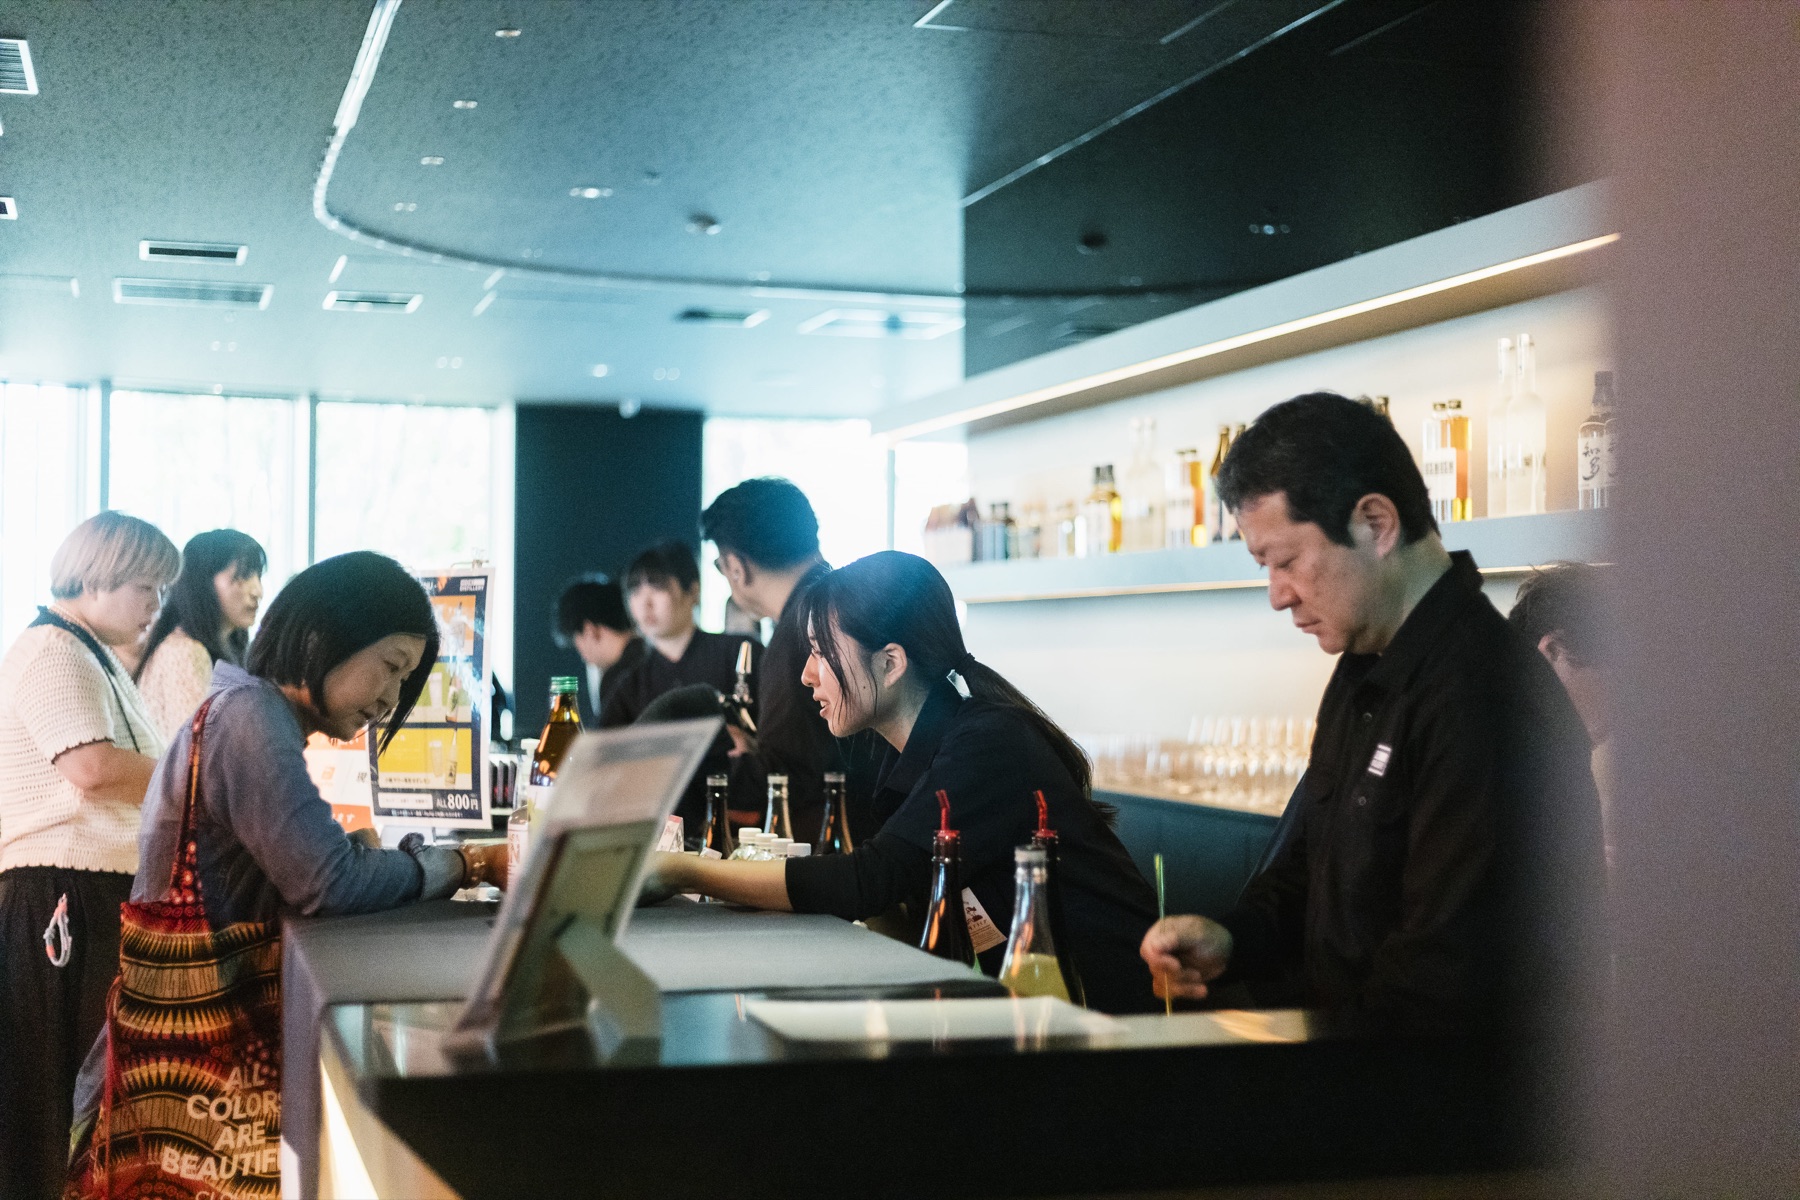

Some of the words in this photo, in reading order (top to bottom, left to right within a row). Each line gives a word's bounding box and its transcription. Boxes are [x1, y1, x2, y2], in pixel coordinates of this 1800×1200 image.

[436, 798, 448, 808] ALL
[447, 793, 479, 810] 800円
[224, 1063, 265, 1091] ALL
[213, 1121, 266, 1151] ARE
[160, 1146, 281, 1181] BEAUTIF
